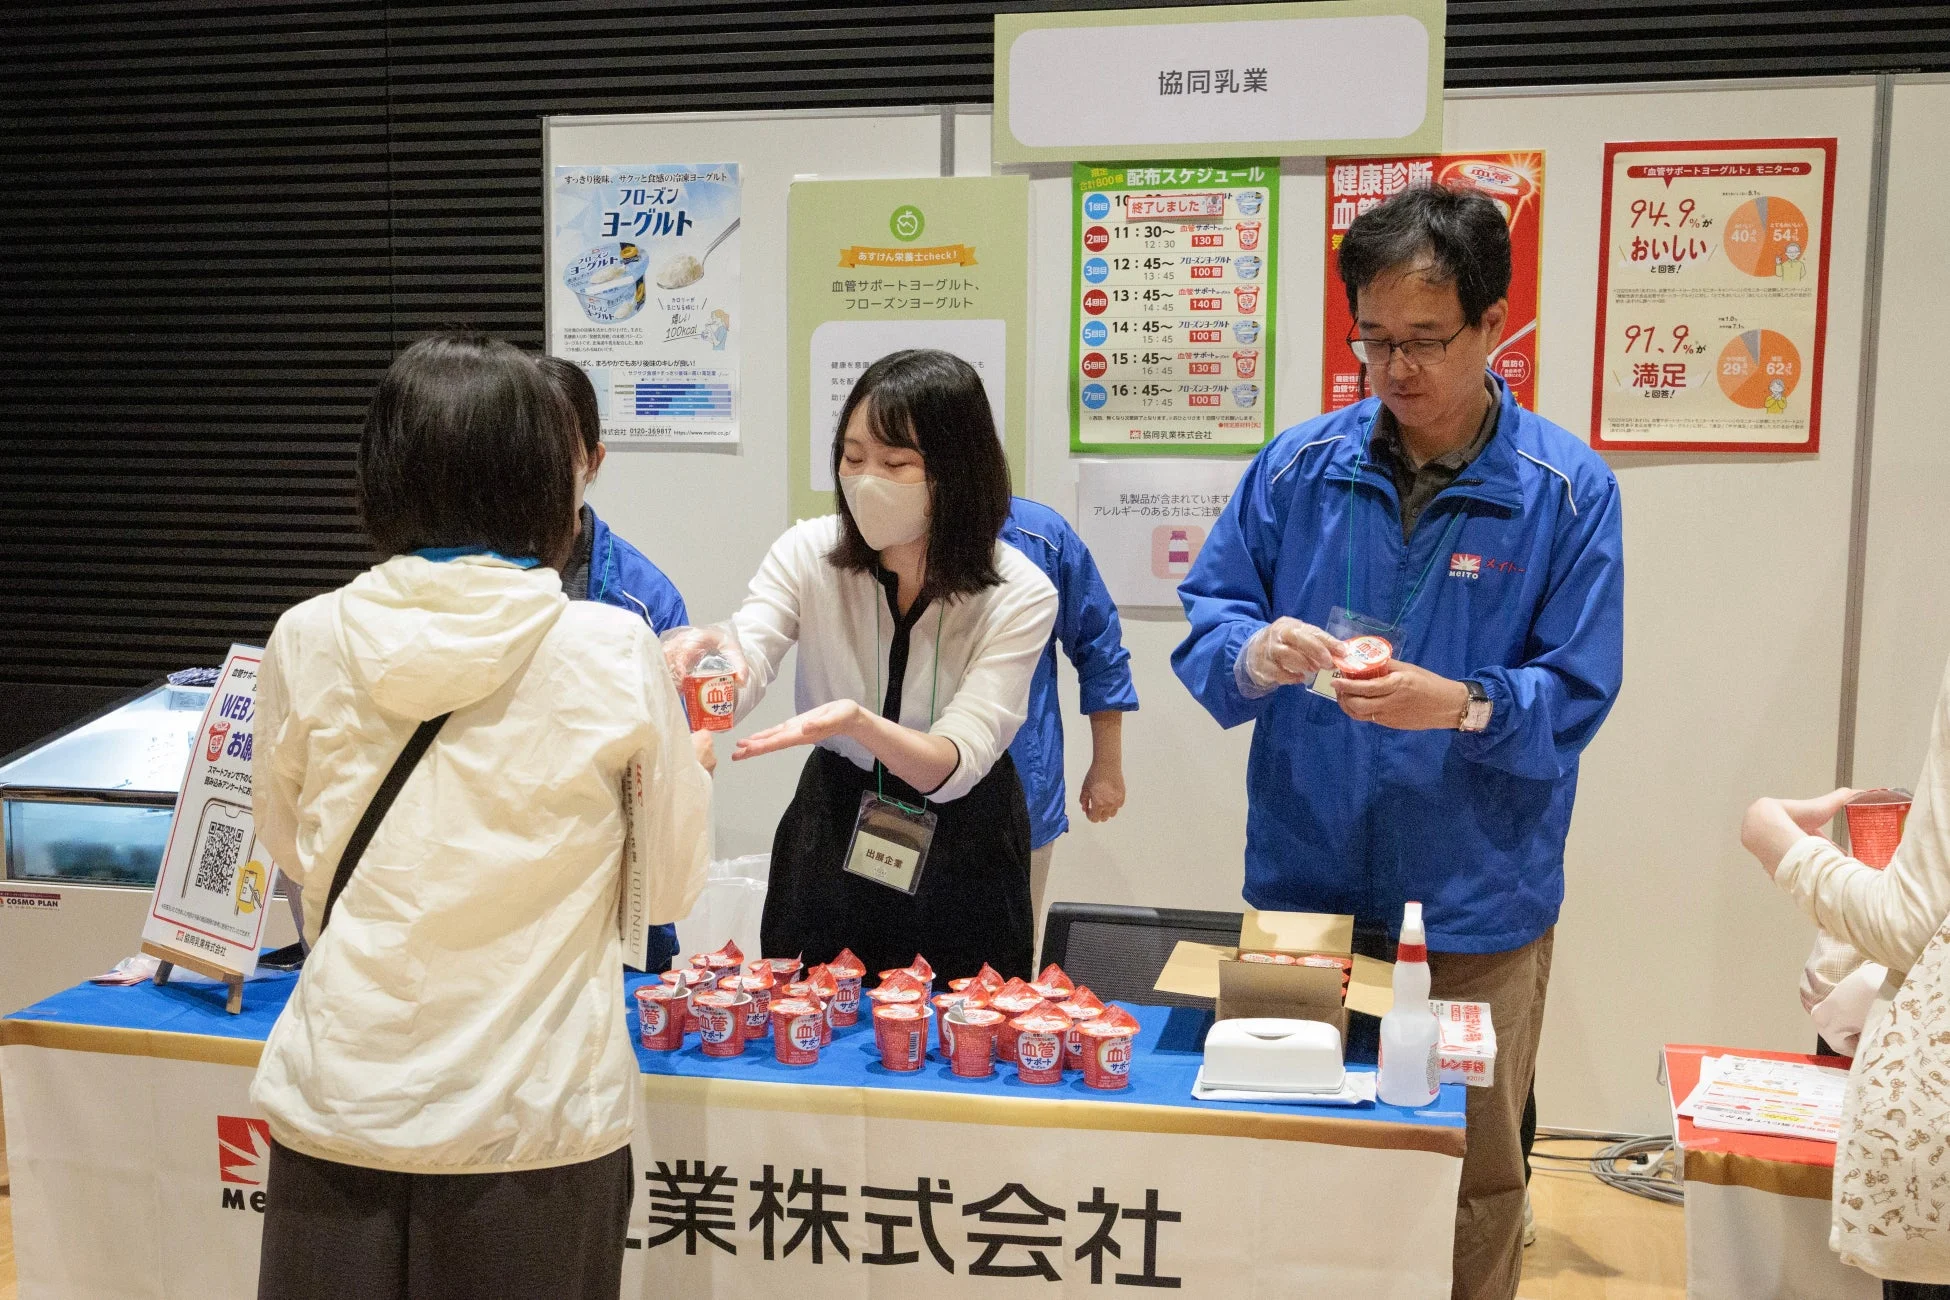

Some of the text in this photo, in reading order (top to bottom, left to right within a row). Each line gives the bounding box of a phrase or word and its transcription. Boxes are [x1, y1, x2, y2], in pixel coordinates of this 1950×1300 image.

[1158, 68, 1267, 95] 協同乳業
[1126, 167, 1265, 187] 配布スケジュール
[1333, 161, 1433, 196] 健康診断
[620, 187, 679, 206] フローズン
[1132, 201, 1200, 214] 終了しました
[602, 208, 692, 237] ヨーグルト
[1194, 236, 1222, 245] 130個
[1631, 235, 1707, 262] おいしい
[1180, 256, 1231, 264] フローズンヨーグルト
[1193, 267, 1222, 276] 100個
[1650, 265, 1682, 274] と回答！
[832, 279, 979, 292] 血管サポートヨーグルト、
[845, 297, 974, 310] フローズンヨーグルト
[1193, 299, 1221, 309] 140個
[1178, 320, 1230, 329] フローズンヨーグルト
[1192, 331, 1220, 341] 100個
[1192, 364, 1219, 373] 130個
[1632, 363, 1687, 388] 満足
[1178, 384, 1229, 392] フローズンヨーグルト
[1644, 389, 1675, 398] と回答！
[1192, 396, 1219, 405] 100個
[1143, 430, 1212, 440] 協同乳業株式会社
[866, 848, 903, 869] 出展企業
[7, 898, 35, 906] COSMO
[1022, 1041, 1055, 1058] 血管
[1025, 1057, 1051, 1066] サポート
[626, 1159, 1182, 1289] 業株式会社
